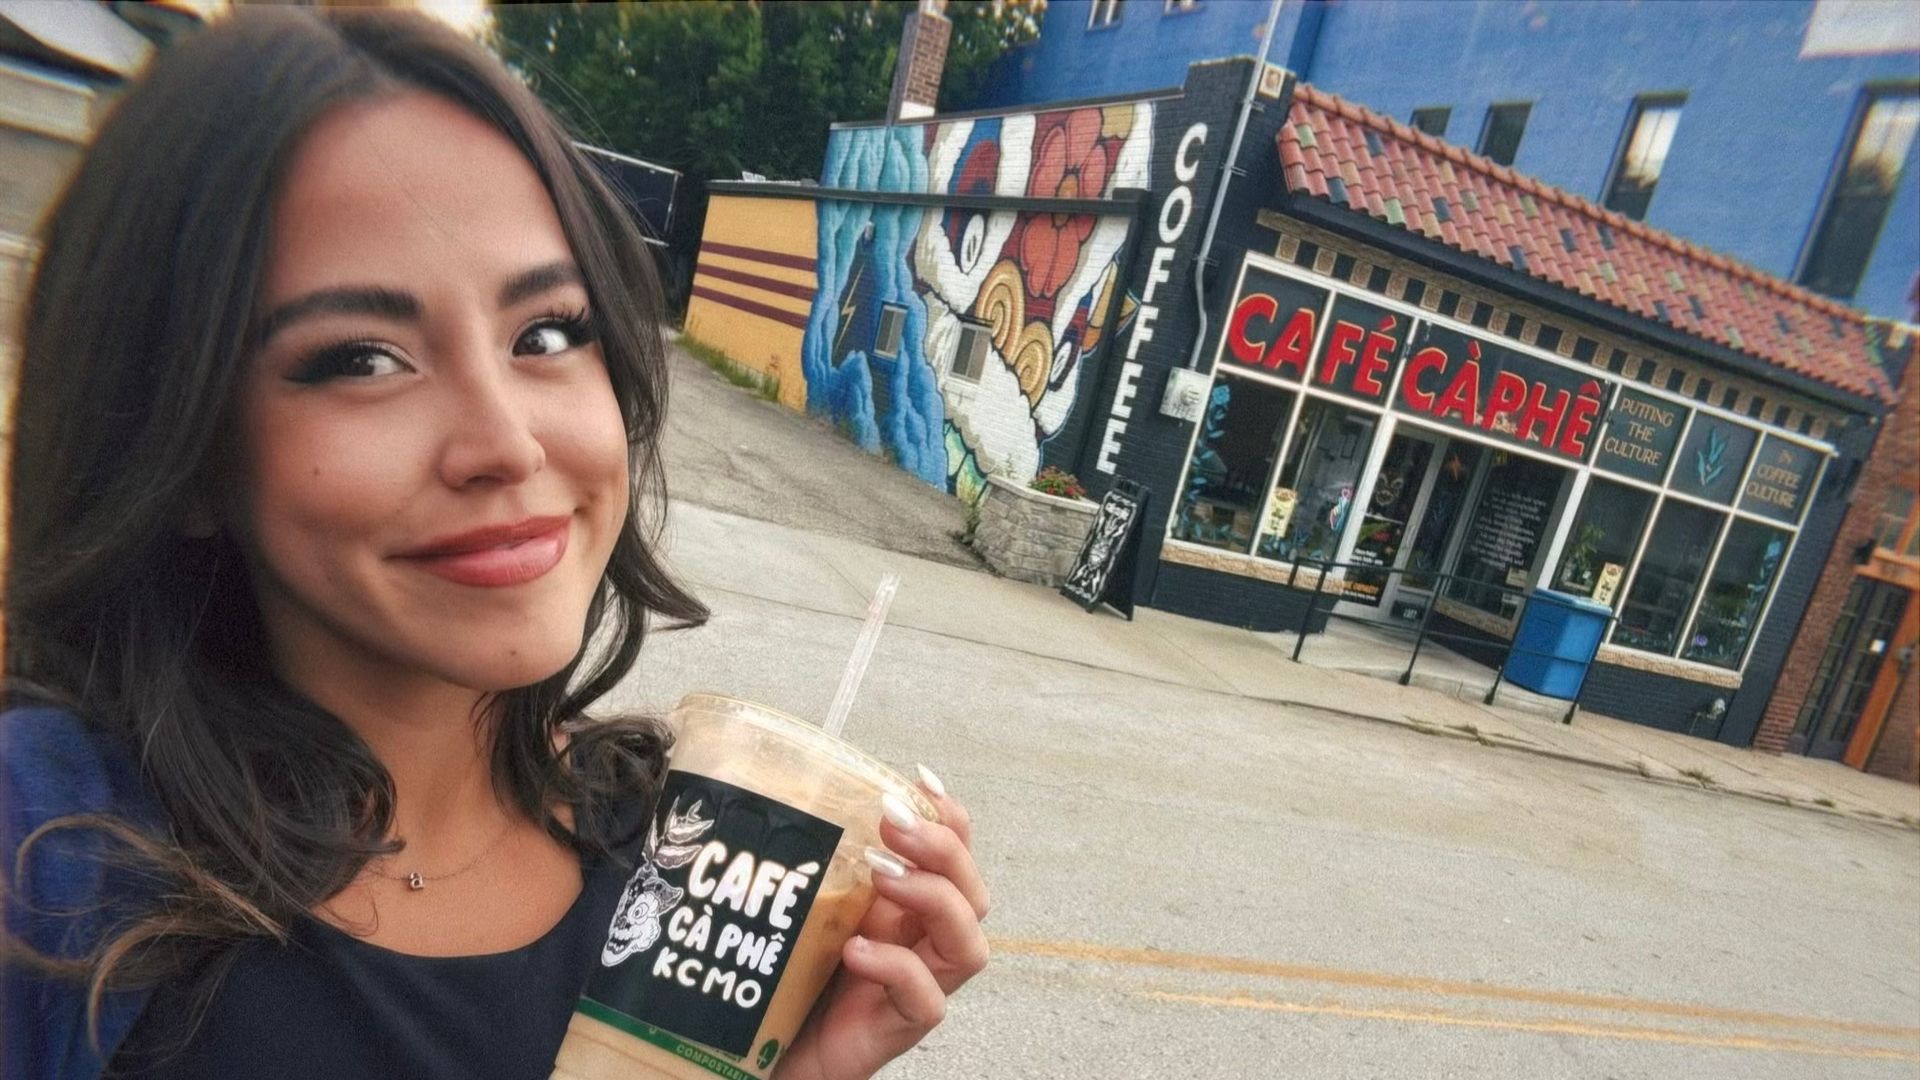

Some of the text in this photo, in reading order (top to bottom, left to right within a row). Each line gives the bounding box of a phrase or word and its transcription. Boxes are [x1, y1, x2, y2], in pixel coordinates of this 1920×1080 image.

[1096, 122, 1208, 475] COFFEE
[1227, 293, 1397, 396] CAFÉ
[1619, 397, 1675, 428] PUTTING
[1627, 420, 1656, 442] THE
[1604, 437, 1662, 467] CULTURE
[1757, 463, 1800, 489] COFFEE
[1747, 483, 1797, 509] CULTURE
[688, 840, 820, 930] CAFÉ
[667, 904, 786, 976] CÀ PHÊ
